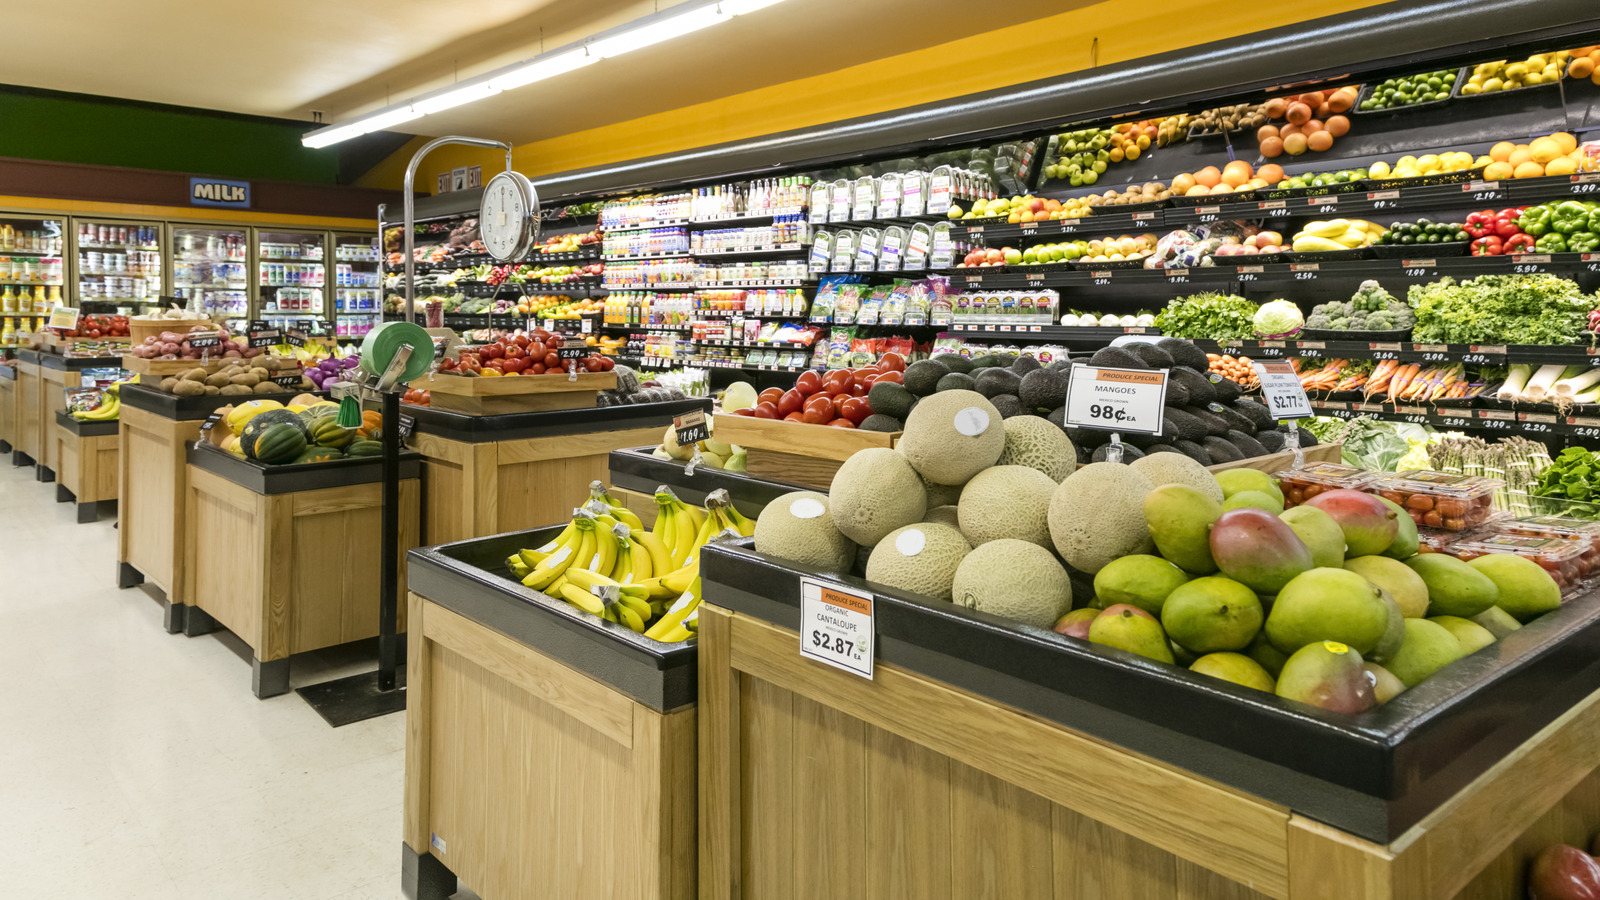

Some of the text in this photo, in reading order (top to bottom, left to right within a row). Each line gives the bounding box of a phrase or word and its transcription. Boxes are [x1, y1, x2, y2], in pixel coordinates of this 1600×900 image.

[194, 183, 246, 202] MILK
[1102, 373, 1132, 381] PRODUCE
[1095, 385, 1136, 395] MANGOES
[1274, 396, 1297, 408] $2.77
[1090, 404, 1126, 423] 98¢
[681, 428, 698, 442] $1.69
[825, 593, 868, 610] PRODUCE SPECIAL
[825, 604, 848, 617] ORGANIC
[817, 613, 857, 632] CANTALOUPE
[813, 630, 854, 656] $2.87
